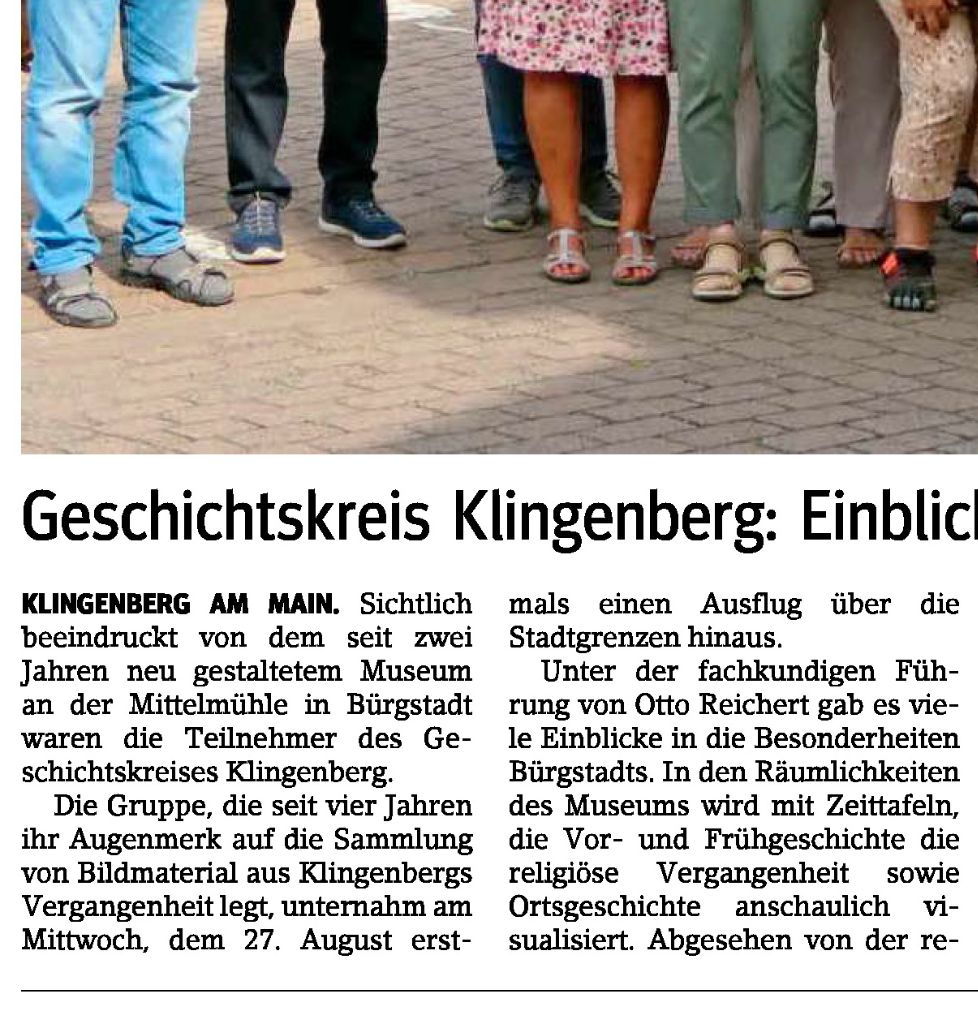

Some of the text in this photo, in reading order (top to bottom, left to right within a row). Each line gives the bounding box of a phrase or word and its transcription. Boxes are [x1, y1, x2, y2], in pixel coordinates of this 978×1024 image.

[23, 488, 429, 541] Geschichtskreis
[456, 488, 776, 553] Klingenberg:
[23, 592, 472, 614] KLINGENBERG AM MAIN. Sichtlich
[509, 592, 959, 620] mals einen Ausflug über die
[21, 625, 472, 648] beeindruckt von dem seit zwei
[510, 625, 781, 653] Stadtgrenzen hinaus.
[20, 660, 472, 687] Jahren neu gestaltetem Museum
[541, 659, 958, 687] Unter der fachkundigen Füh-
[509, 693, 958, 721] rung von Otto Reichert gab es vie-
[21, 726, 471, 749] waren die Teilnehmer des Ge-
[23, 760, 392, 788] schichtskreises Klingenberg.
[509, 760, 960, 788] Bürgstadts. In den Räumlichkeiten
[54, 794, 472, 821] Die Gruppe, die seit vier Jahren
[509, 793, 958, 819] des Museums wird mit Zeittafeln,
[21, 862, 472, 889] von Bildmaterial aus Klingenbergs
[509, 862, 959, 889] religiöse Vergangenheit sowie
[22, 928, 471, 956] Mittwoch, dem 27. August erst-
[509, 928, 958, 956] sualisiert. Abgesehen von der re-
